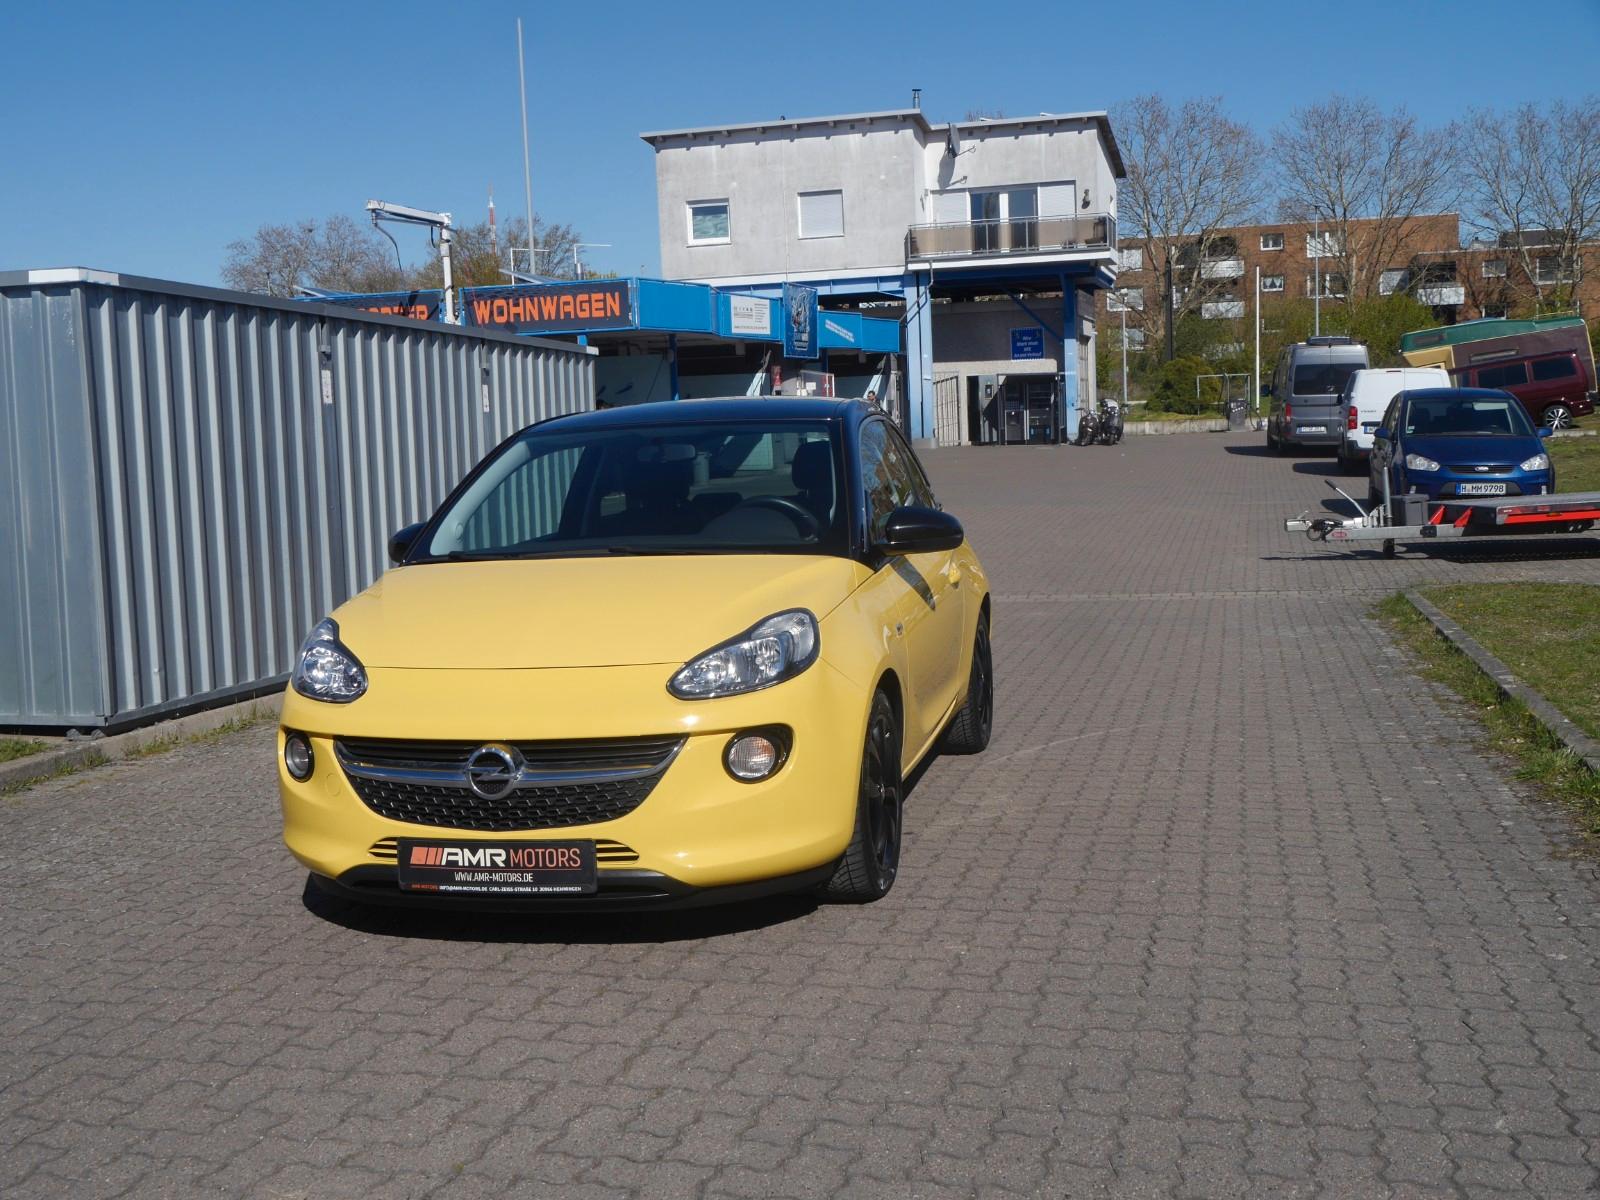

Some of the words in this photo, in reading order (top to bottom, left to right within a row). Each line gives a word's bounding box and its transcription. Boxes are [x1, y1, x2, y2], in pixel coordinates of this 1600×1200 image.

[473, 291, 621, 324] WOHNWAGEN
[441, 847, 506, 867] AMR
[509, 847, 581, 867] MOTORS
[454, 872, 534, 883] WWW.AMR-MOTORS.DE
